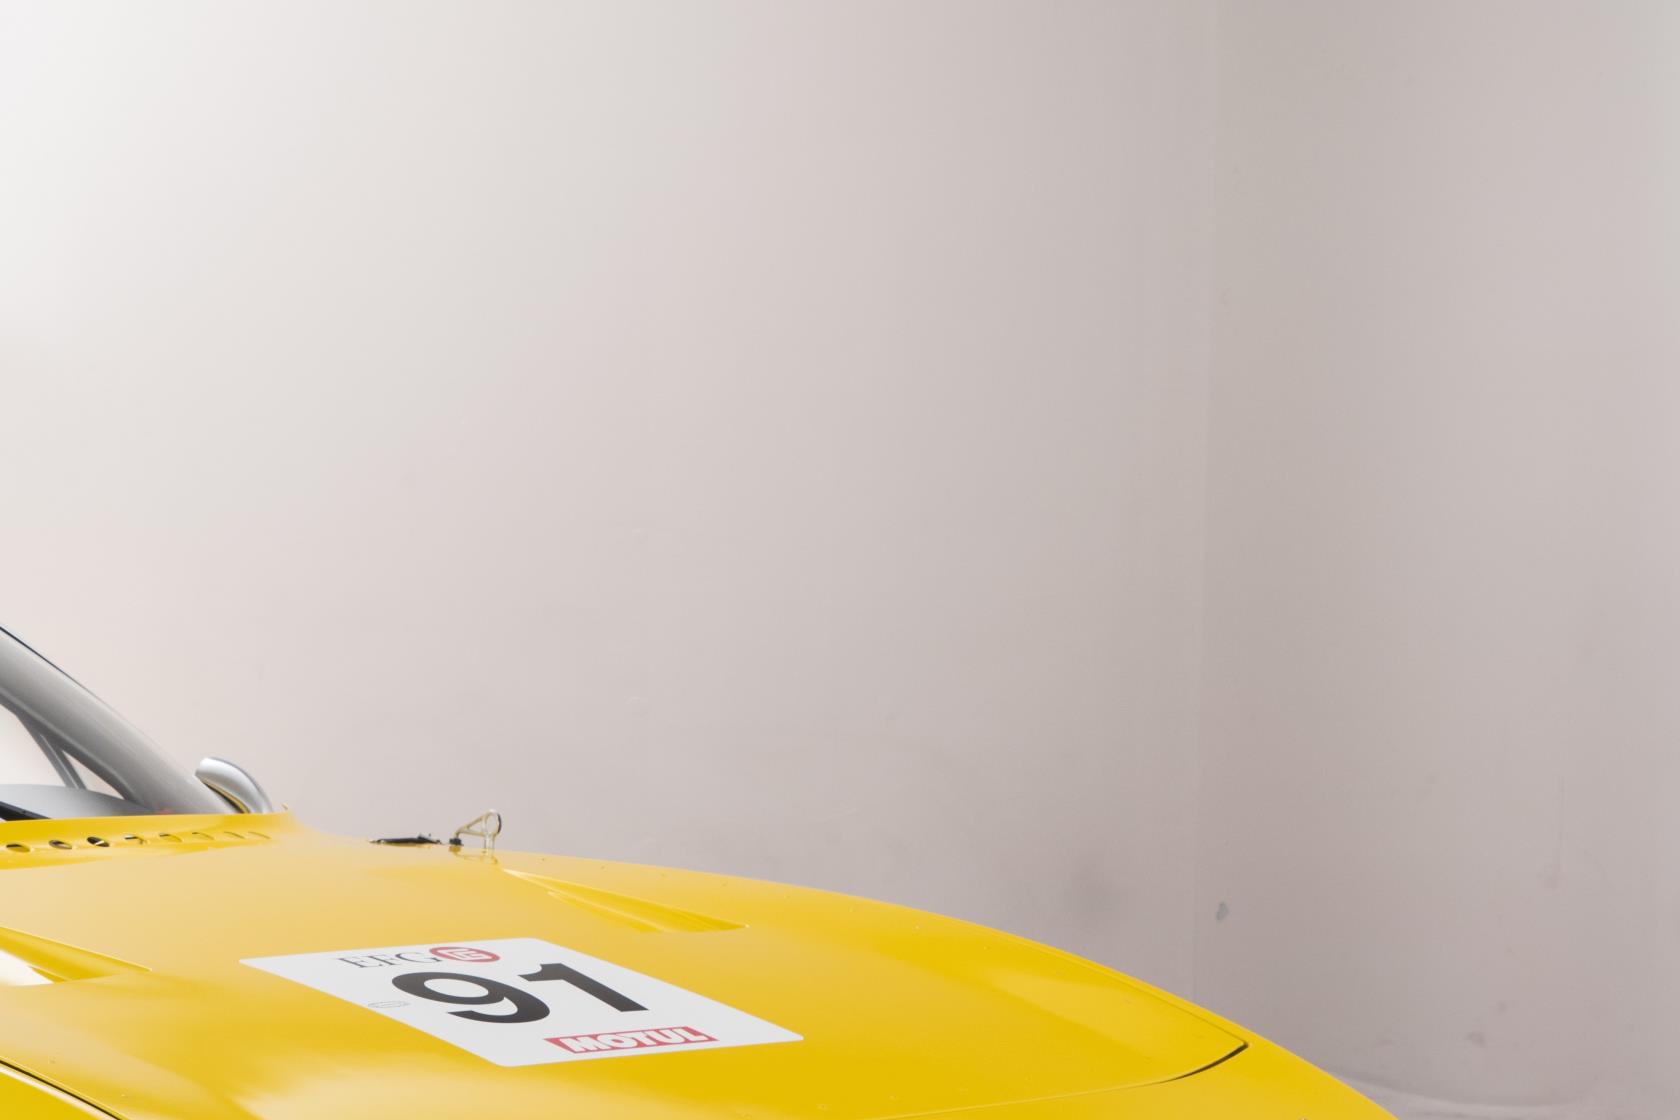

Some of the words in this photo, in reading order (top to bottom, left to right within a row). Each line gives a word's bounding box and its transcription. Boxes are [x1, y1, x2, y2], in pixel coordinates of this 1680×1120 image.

[338, 952, 443, 968] EFG
[392, 963, 649, 1024] 91
[558, 1027, 708, 1053] MOTUL
